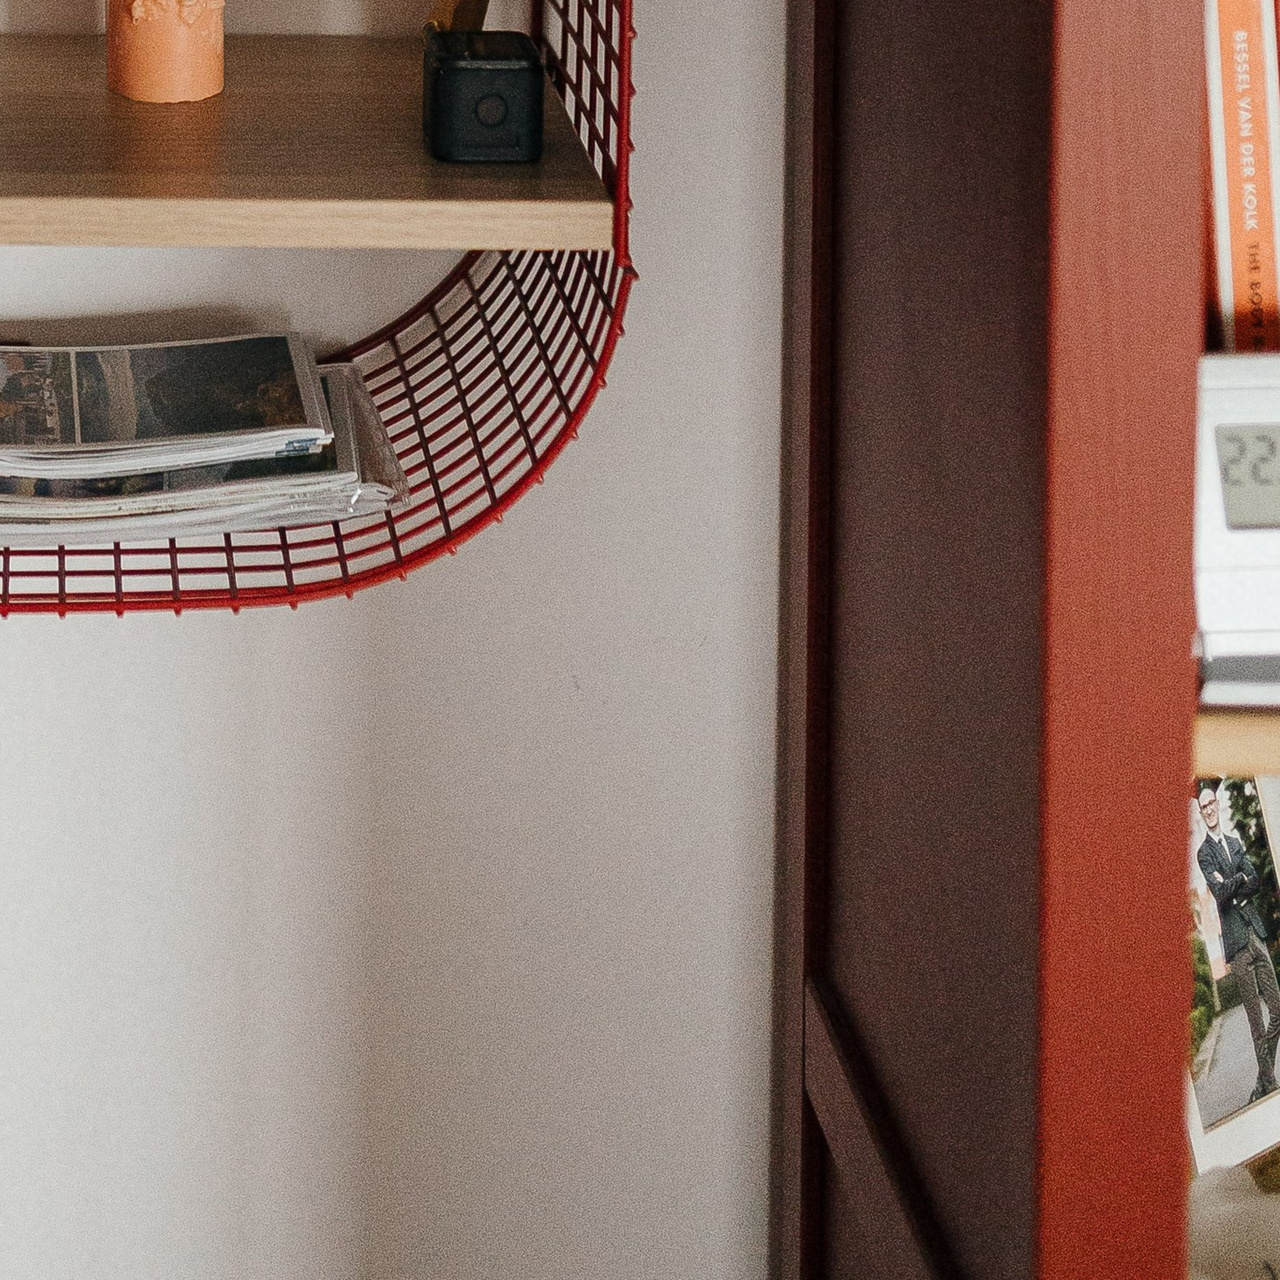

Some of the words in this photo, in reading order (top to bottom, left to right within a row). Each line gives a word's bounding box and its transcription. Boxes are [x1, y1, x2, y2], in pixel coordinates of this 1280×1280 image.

[1233, 30, 1251, 93] BESSEL
[1237, 97, 1253, 137] VAN
[1239, 143, 1255, 177] DER
[1242, 183, 1259, 231] KOLK
[1248, 242, 1261, 274] THE
